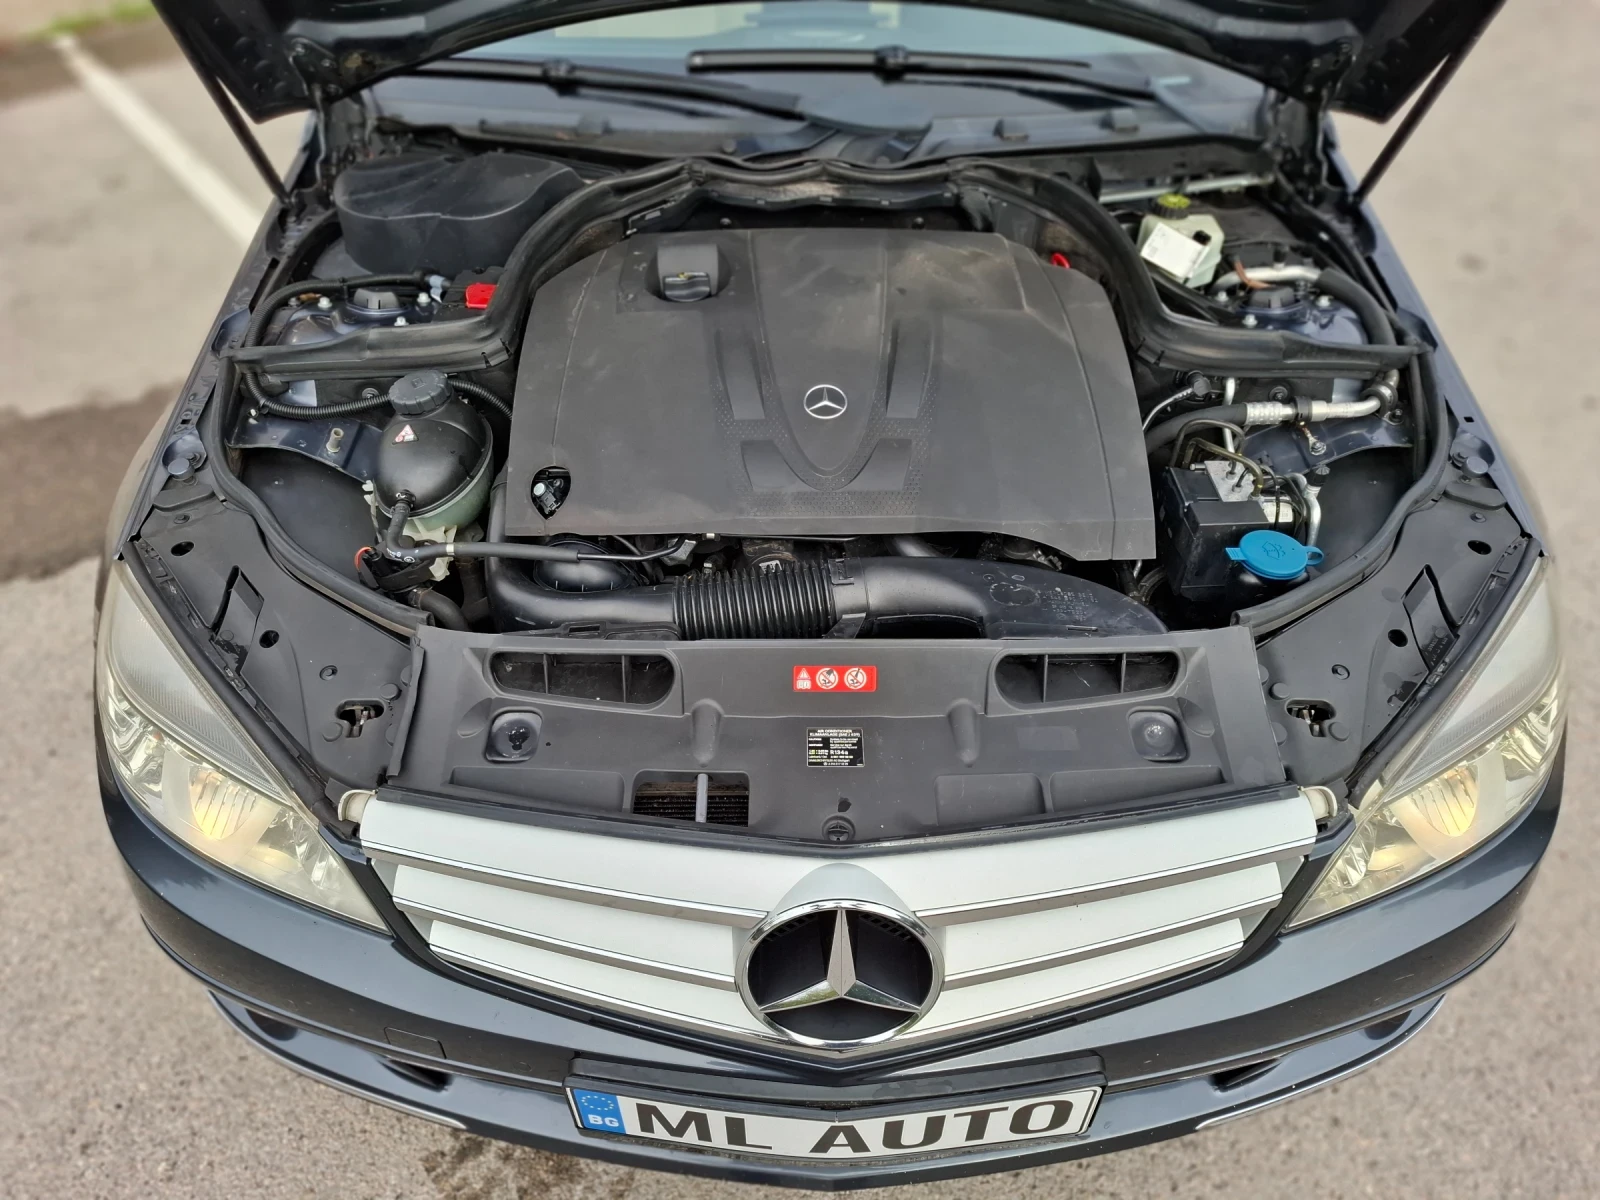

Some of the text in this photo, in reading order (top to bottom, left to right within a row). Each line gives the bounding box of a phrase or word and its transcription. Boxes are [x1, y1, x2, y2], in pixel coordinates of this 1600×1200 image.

[588, 1114, 620, 1128] BG
[637, 1099, 1074, 1154] ML AUTO
